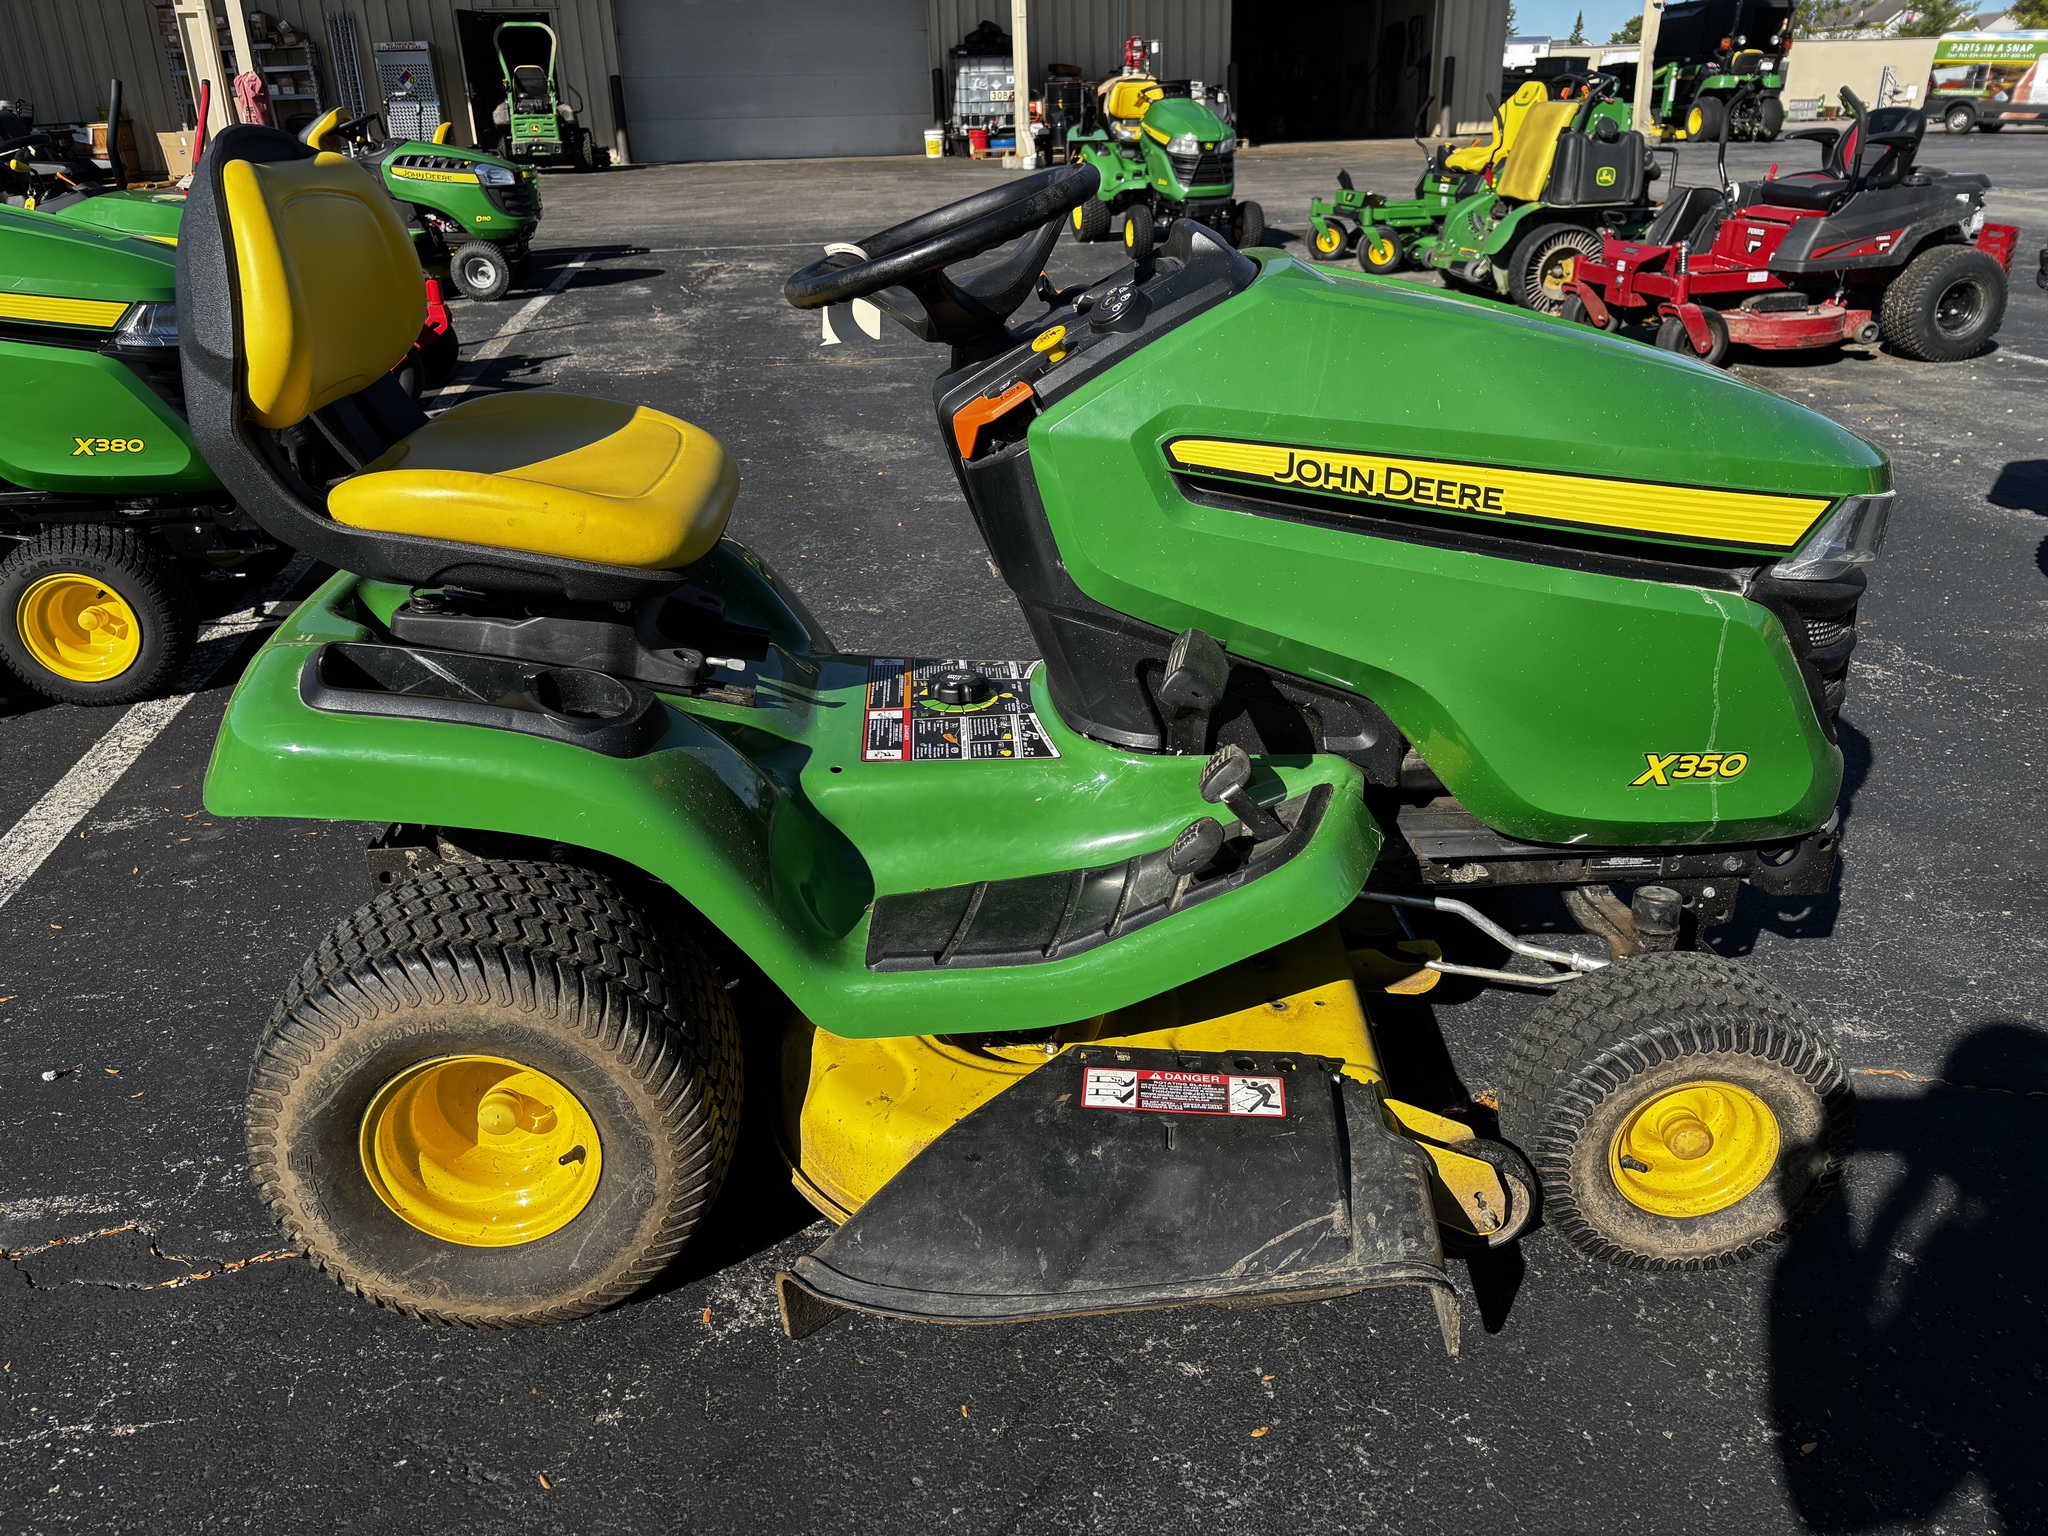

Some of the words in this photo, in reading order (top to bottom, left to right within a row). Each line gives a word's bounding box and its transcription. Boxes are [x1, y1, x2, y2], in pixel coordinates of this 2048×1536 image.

[1951, 43, 1981, 52] PARTS
[1984, 44, 1995, 52] IN
[1996, 44, 2004, 52] A
[2007, 44, 2034, 52] SNAP
[403, 170, 424, 179] JOHN
[425, 173, 452, 182] DEERE
[1747, 227, 1766, 236] FERRIS
[70, 437, 144, 456] X380
[1274, 452, 1375, 493] JOHN
[1384, 467, 1505, 511] DEERE
[19, 557, 106, 578] CARLSTAR
[1627, 753, 1749, 786] X350
[500, 1023, 603, 1077] MULTI
[1165, 1073, 1220, 1083] DANGER
